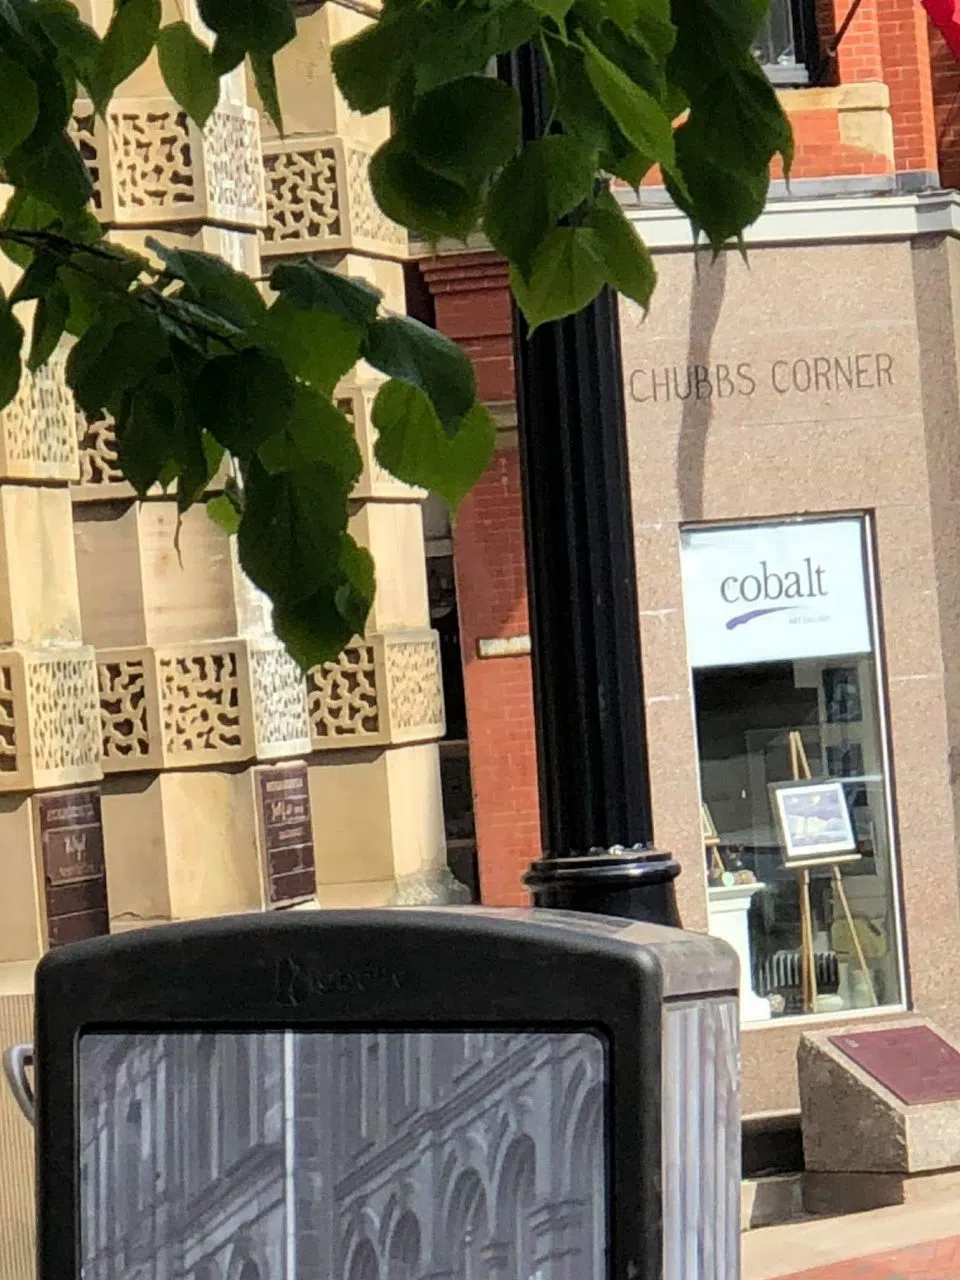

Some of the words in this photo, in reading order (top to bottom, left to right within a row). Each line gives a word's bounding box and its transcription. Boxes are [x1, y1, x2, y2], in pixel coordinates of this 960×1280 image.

[628, 362, 757, 403] CHUBBS
[771, 353, 894, 394] CORNER
[720, 557, 829, 604] cobalt
